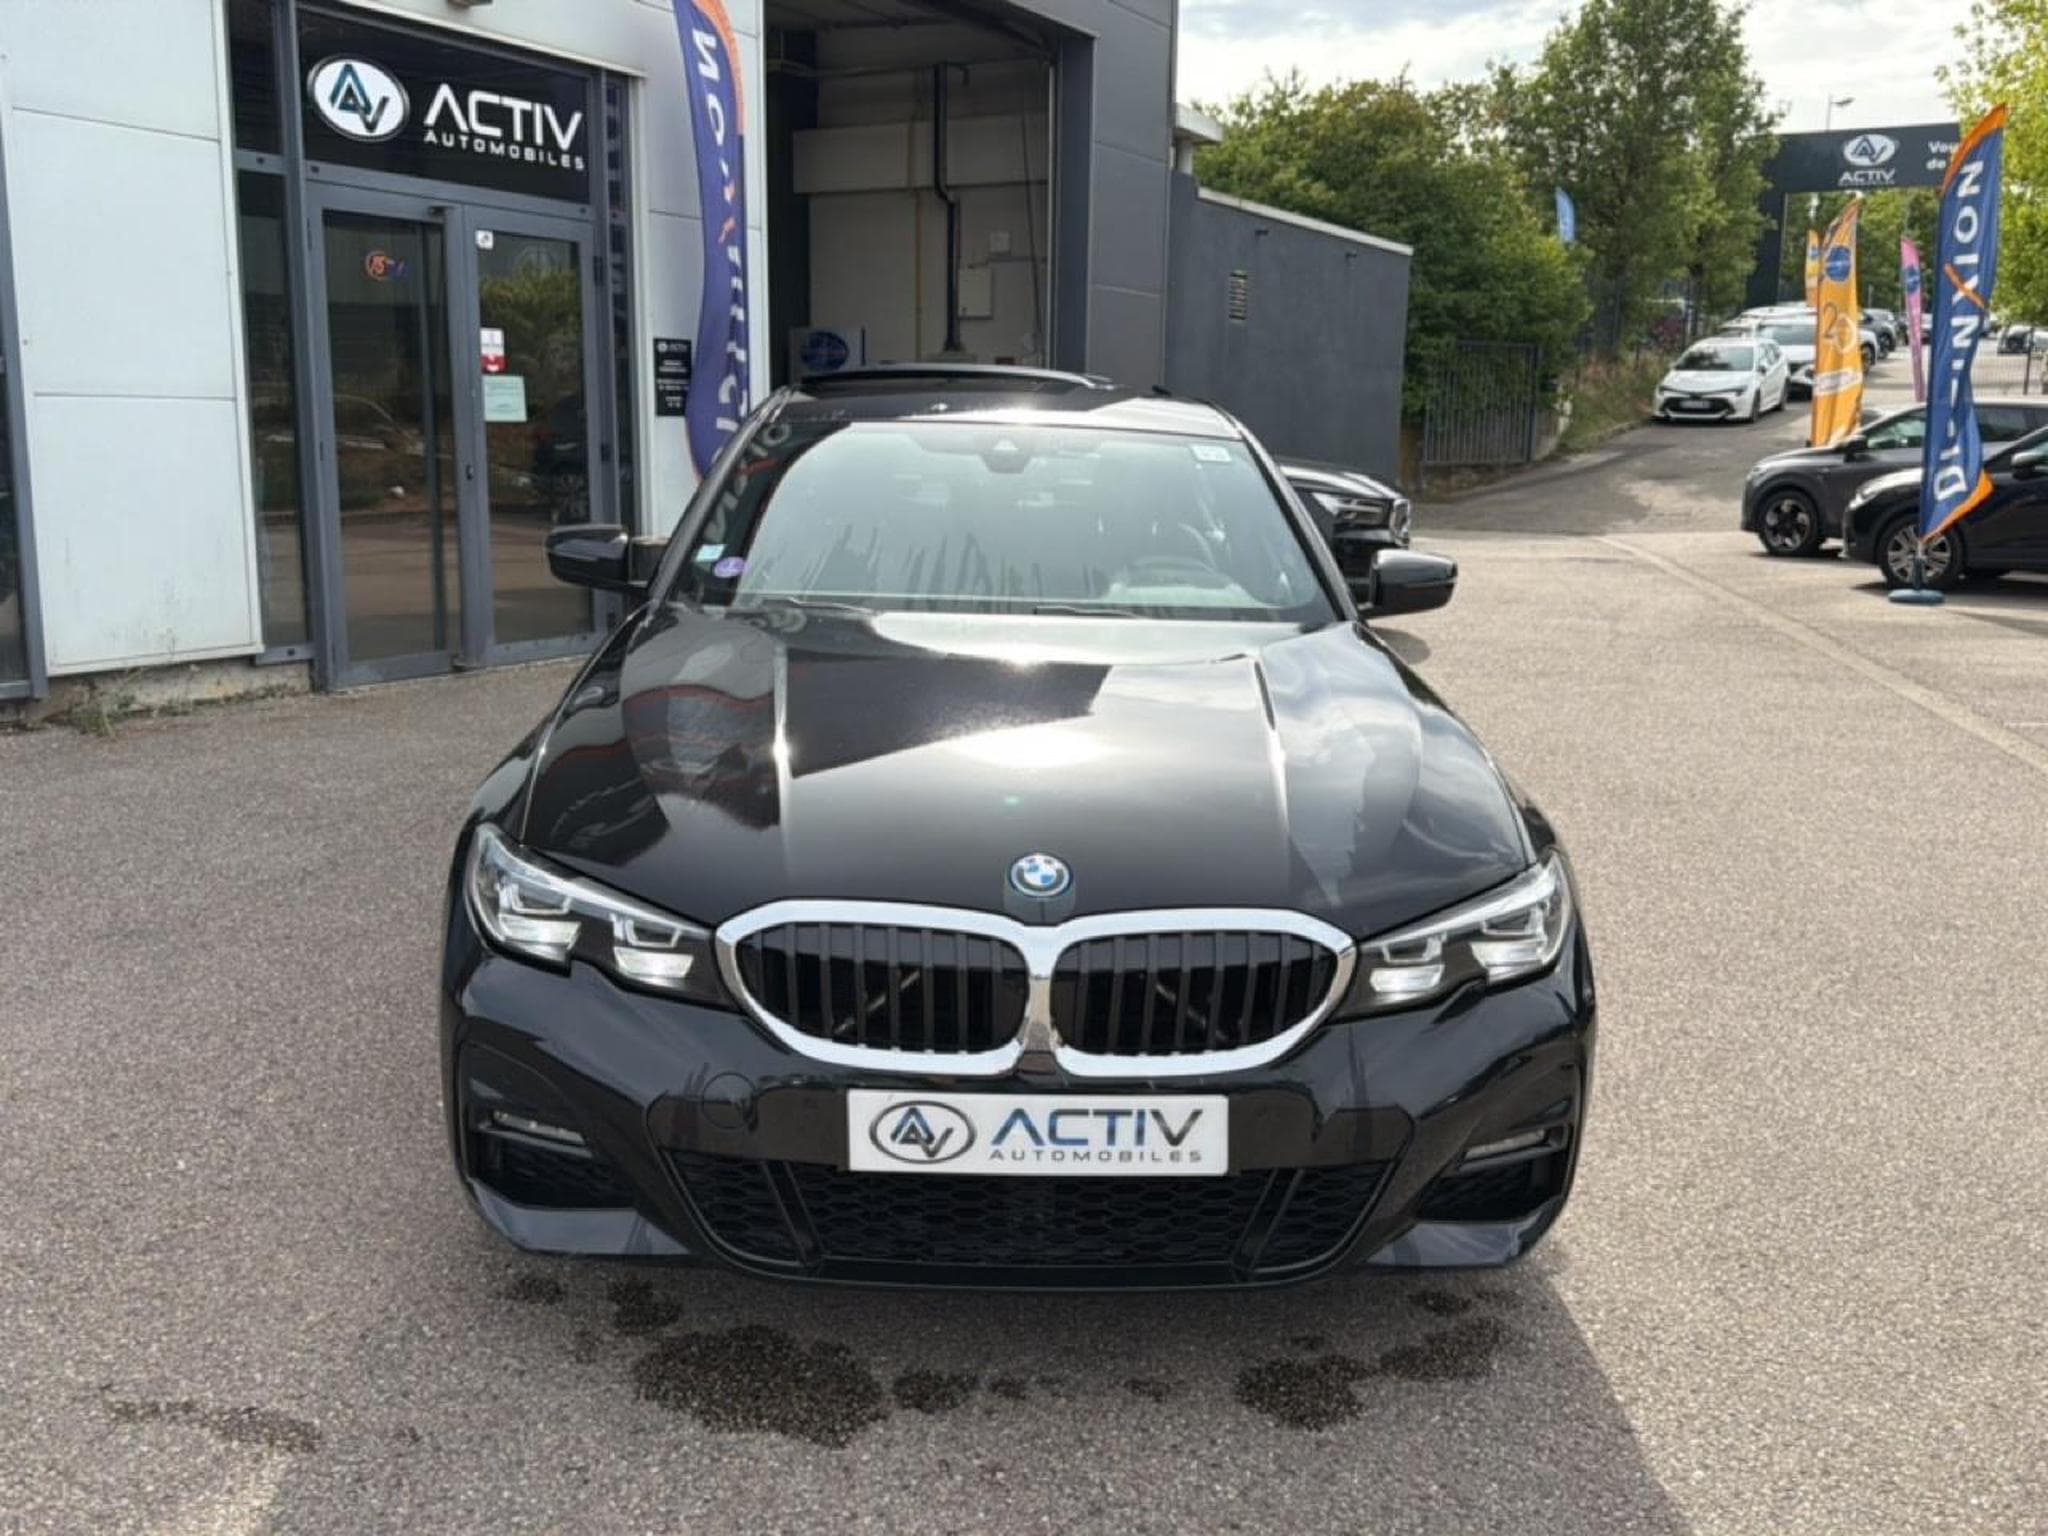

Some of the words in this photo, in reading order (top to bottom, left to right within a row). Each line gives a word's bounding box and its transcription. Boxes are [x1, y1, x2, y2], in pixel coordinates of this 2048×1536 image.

[423, 83, 582, 150] ACTIV
[423, 130, 585, 170] AUTOMOBILES
[1838, 168, 1896, 183] ACTIV
[991, 1108, 1204, 1147] ACTIV
[989, 1150, 1202, 1163] AUTOMOBILES
